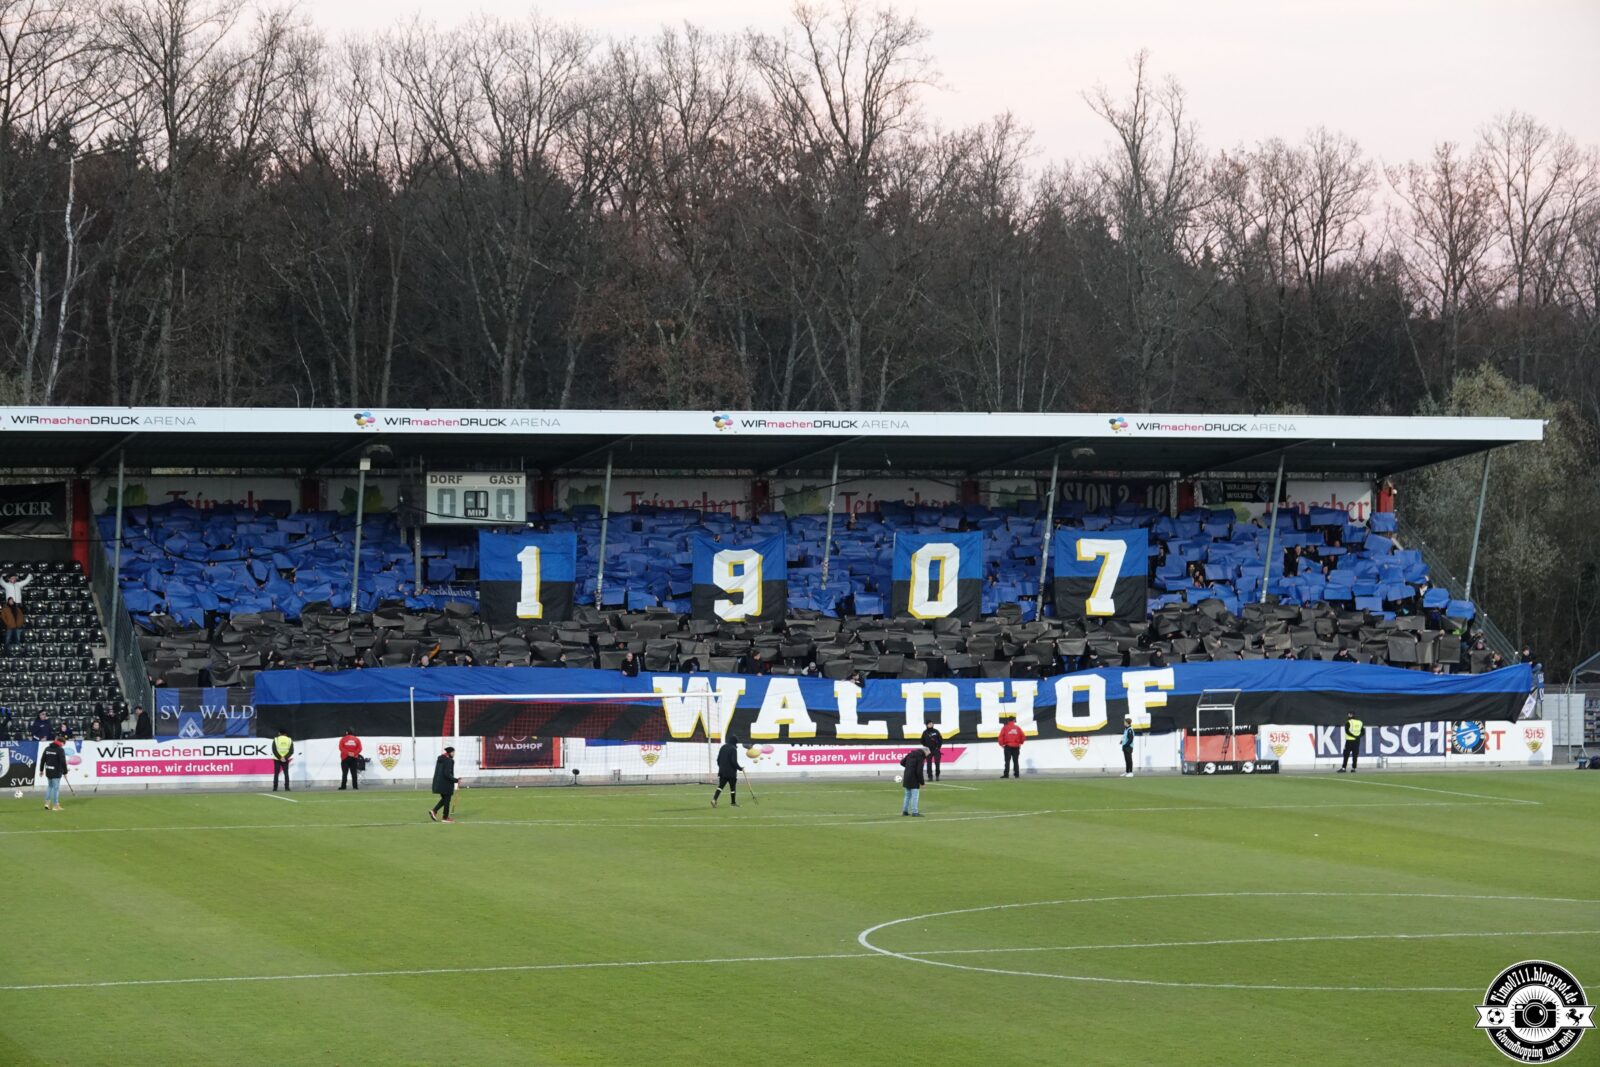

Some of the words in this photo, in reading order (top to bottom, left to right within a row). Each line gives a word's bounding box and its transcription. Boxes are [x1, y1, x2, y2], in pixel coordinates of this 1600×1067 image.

[11, 415, 140, 425] WIRmachenDRUCK
[143, 416, 196, 426] ARENA
[384, 417, 507, 427] WIRmachenDRUCK
[511, 418, 561, 427] ARENA
[741, 419, 858, 429] WIRmachenDRUCK
[861, 420, 910, 429] ARENA
[1135, 422, 1247, 432] WIRmachenDRUCK
[1250, 423, 1296, 432] ARENA
[430, 475, 463, 484] DORF
[489, 475, 522, 485] GAST
[0, 502, 53, 516] CKER
[467, 509, 486, 517] MIN
[652, 667, 1175, 740] WALDHOF
[161, 705, 184, 719] SV
[200, 705, 257, 719] WALD
[495, 742, 543, 750] WALDHOF
[10, 750, 34, 768] TOUR
[791, 753, 807, 762] Sie
[809, 754, 847, 763] sparen,
[849, 752, 865, 761] wir
[101, 764, 118, 774] Sie
[120, 765, 162, 776] sparen,
[165, 763, 182, 773] wir
[185, 763, 234, 772] drucken!
